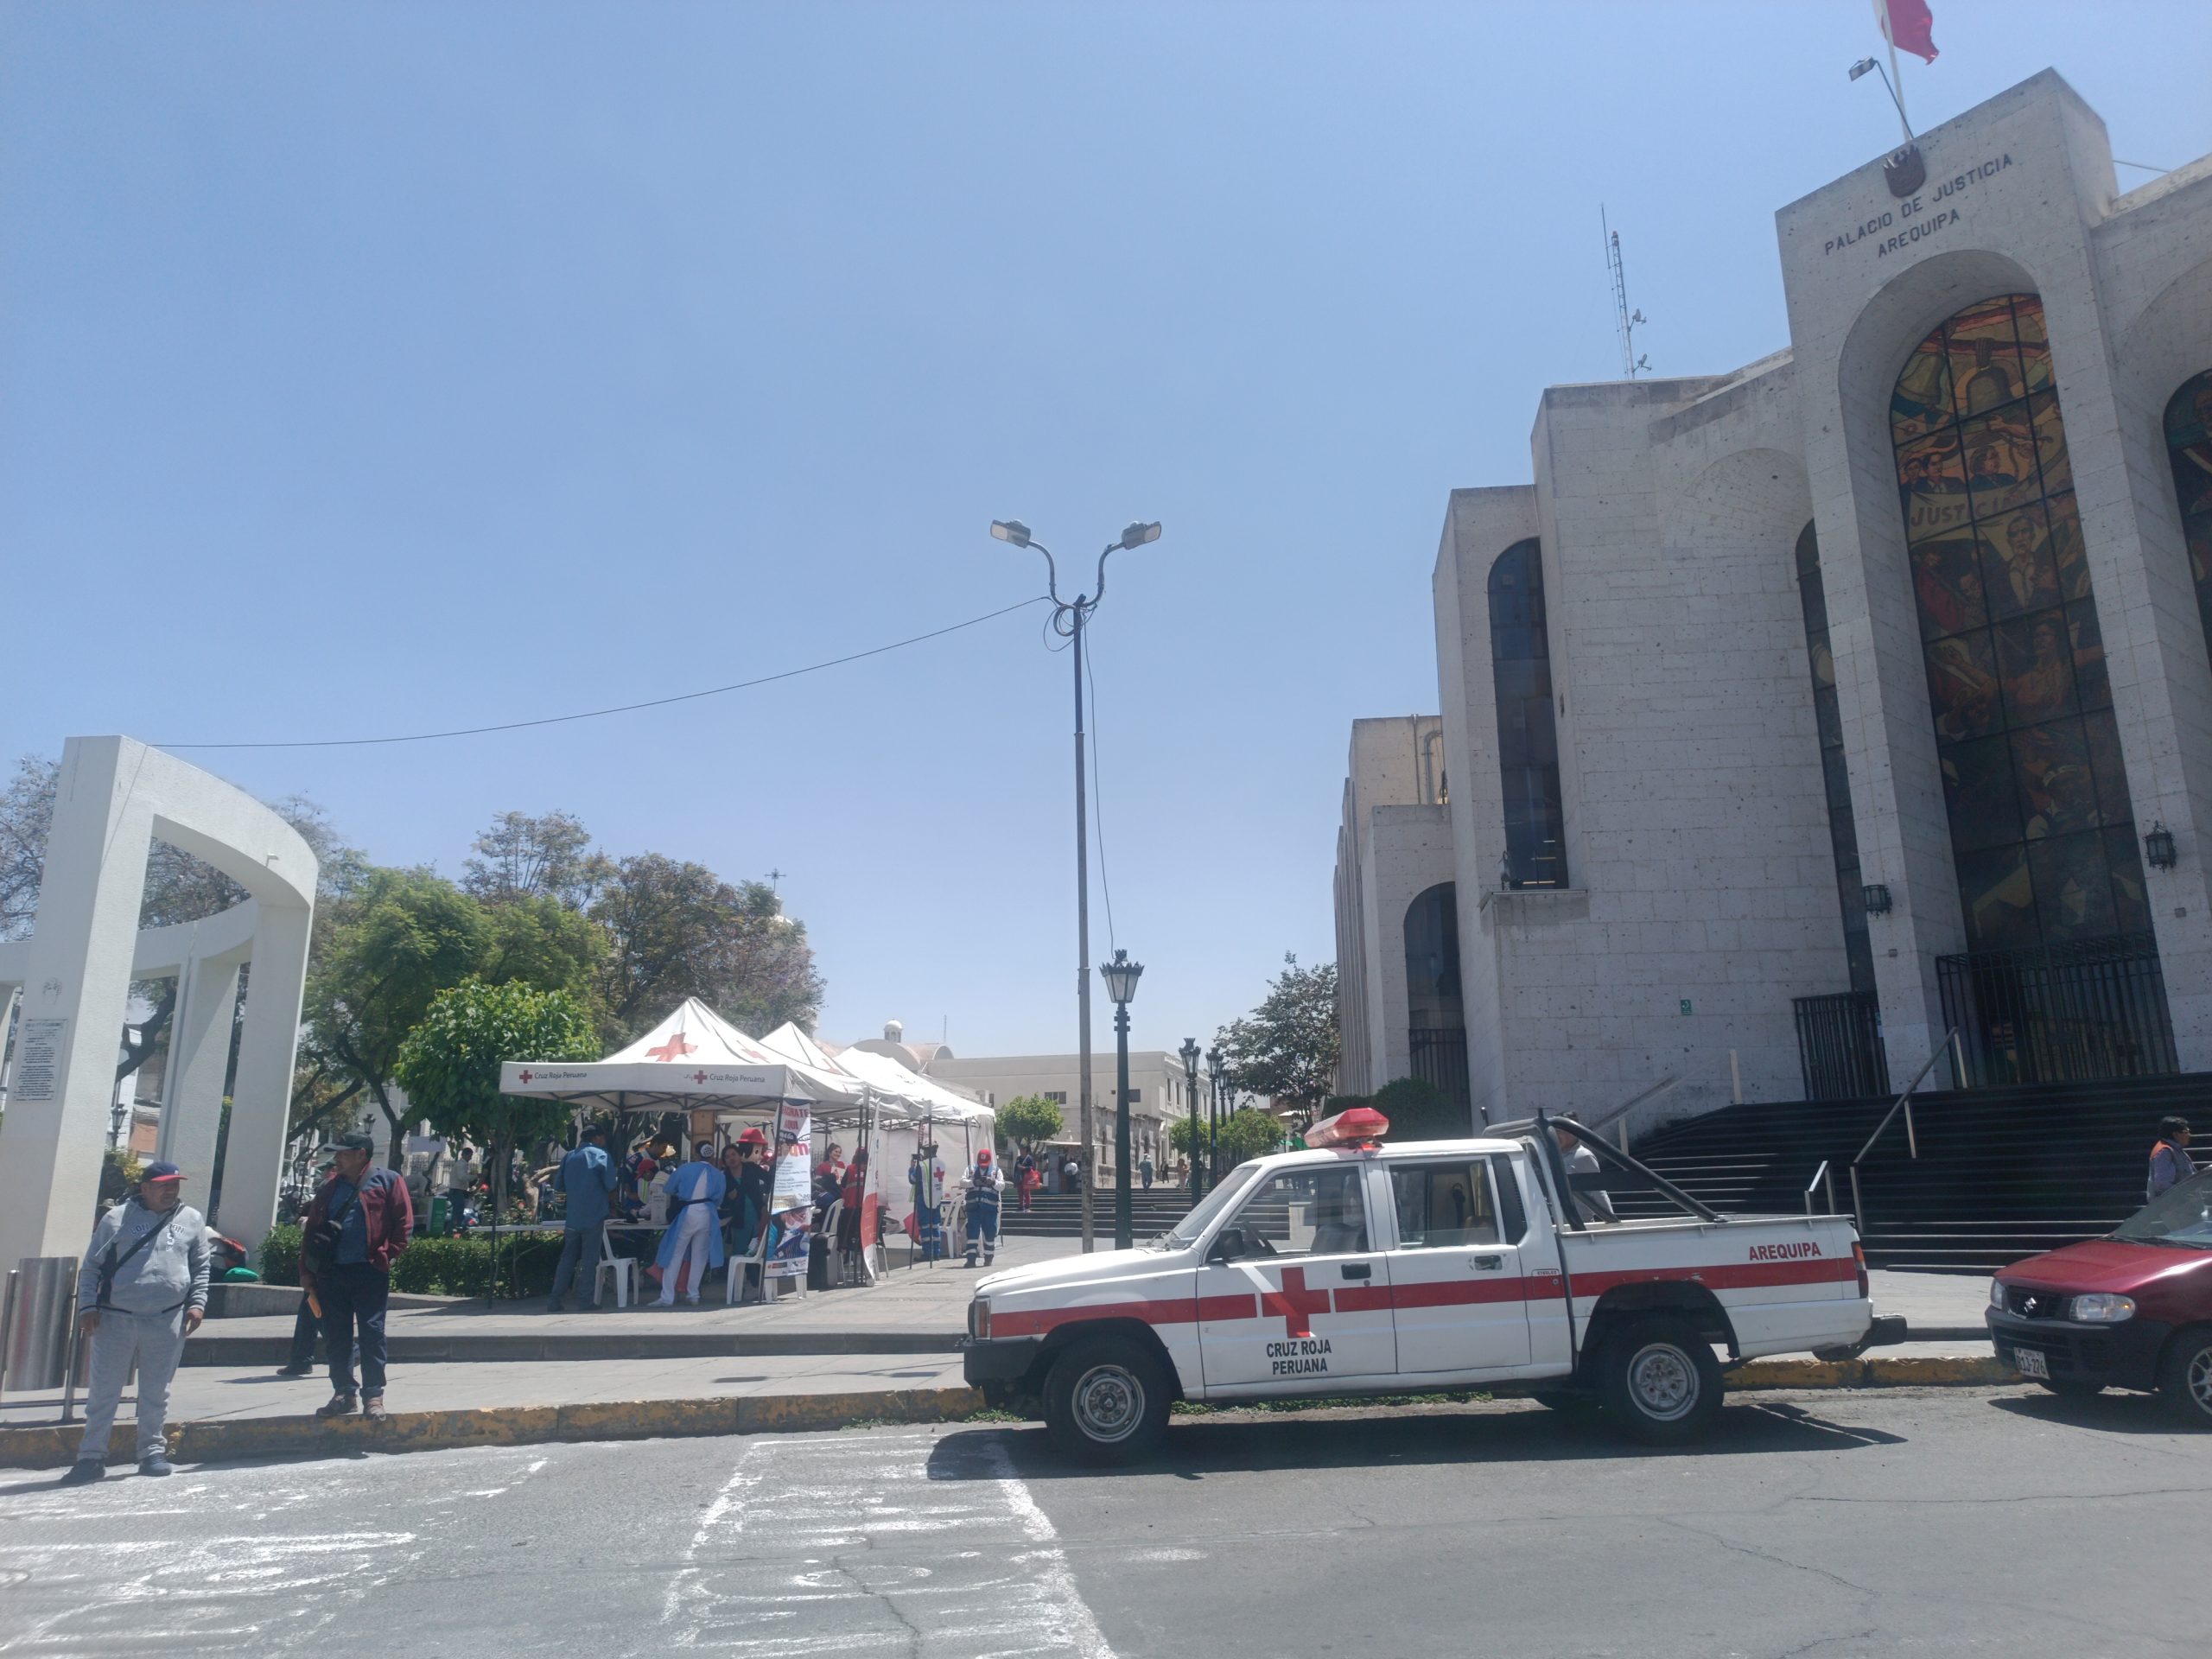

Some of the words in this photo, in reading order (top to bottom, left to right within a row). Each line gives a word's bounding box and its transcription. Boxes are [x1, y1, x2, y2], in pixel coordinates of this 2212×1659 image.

[1824, 211, 1893, 256] PALACIO
[1901, 196, 1924, 219] DE
[1933, 154, 2012, 202] JUSTICIA
[1878, 208, 1961, 257] AREQUIPA
[549, 1071, 562, 1080] Roja
[724, 1073, 739, 1083] Roja
[740, 1074, 766, 1083] Peruana
[1749, 1242, 1822, 1261] AREQUIPA
[1267, 1341, 1298, 1357] CRUZ
[1301, 1338, 1332, 1356] ROJA
[1272, 1357, 1328, 1375] PERUANA
